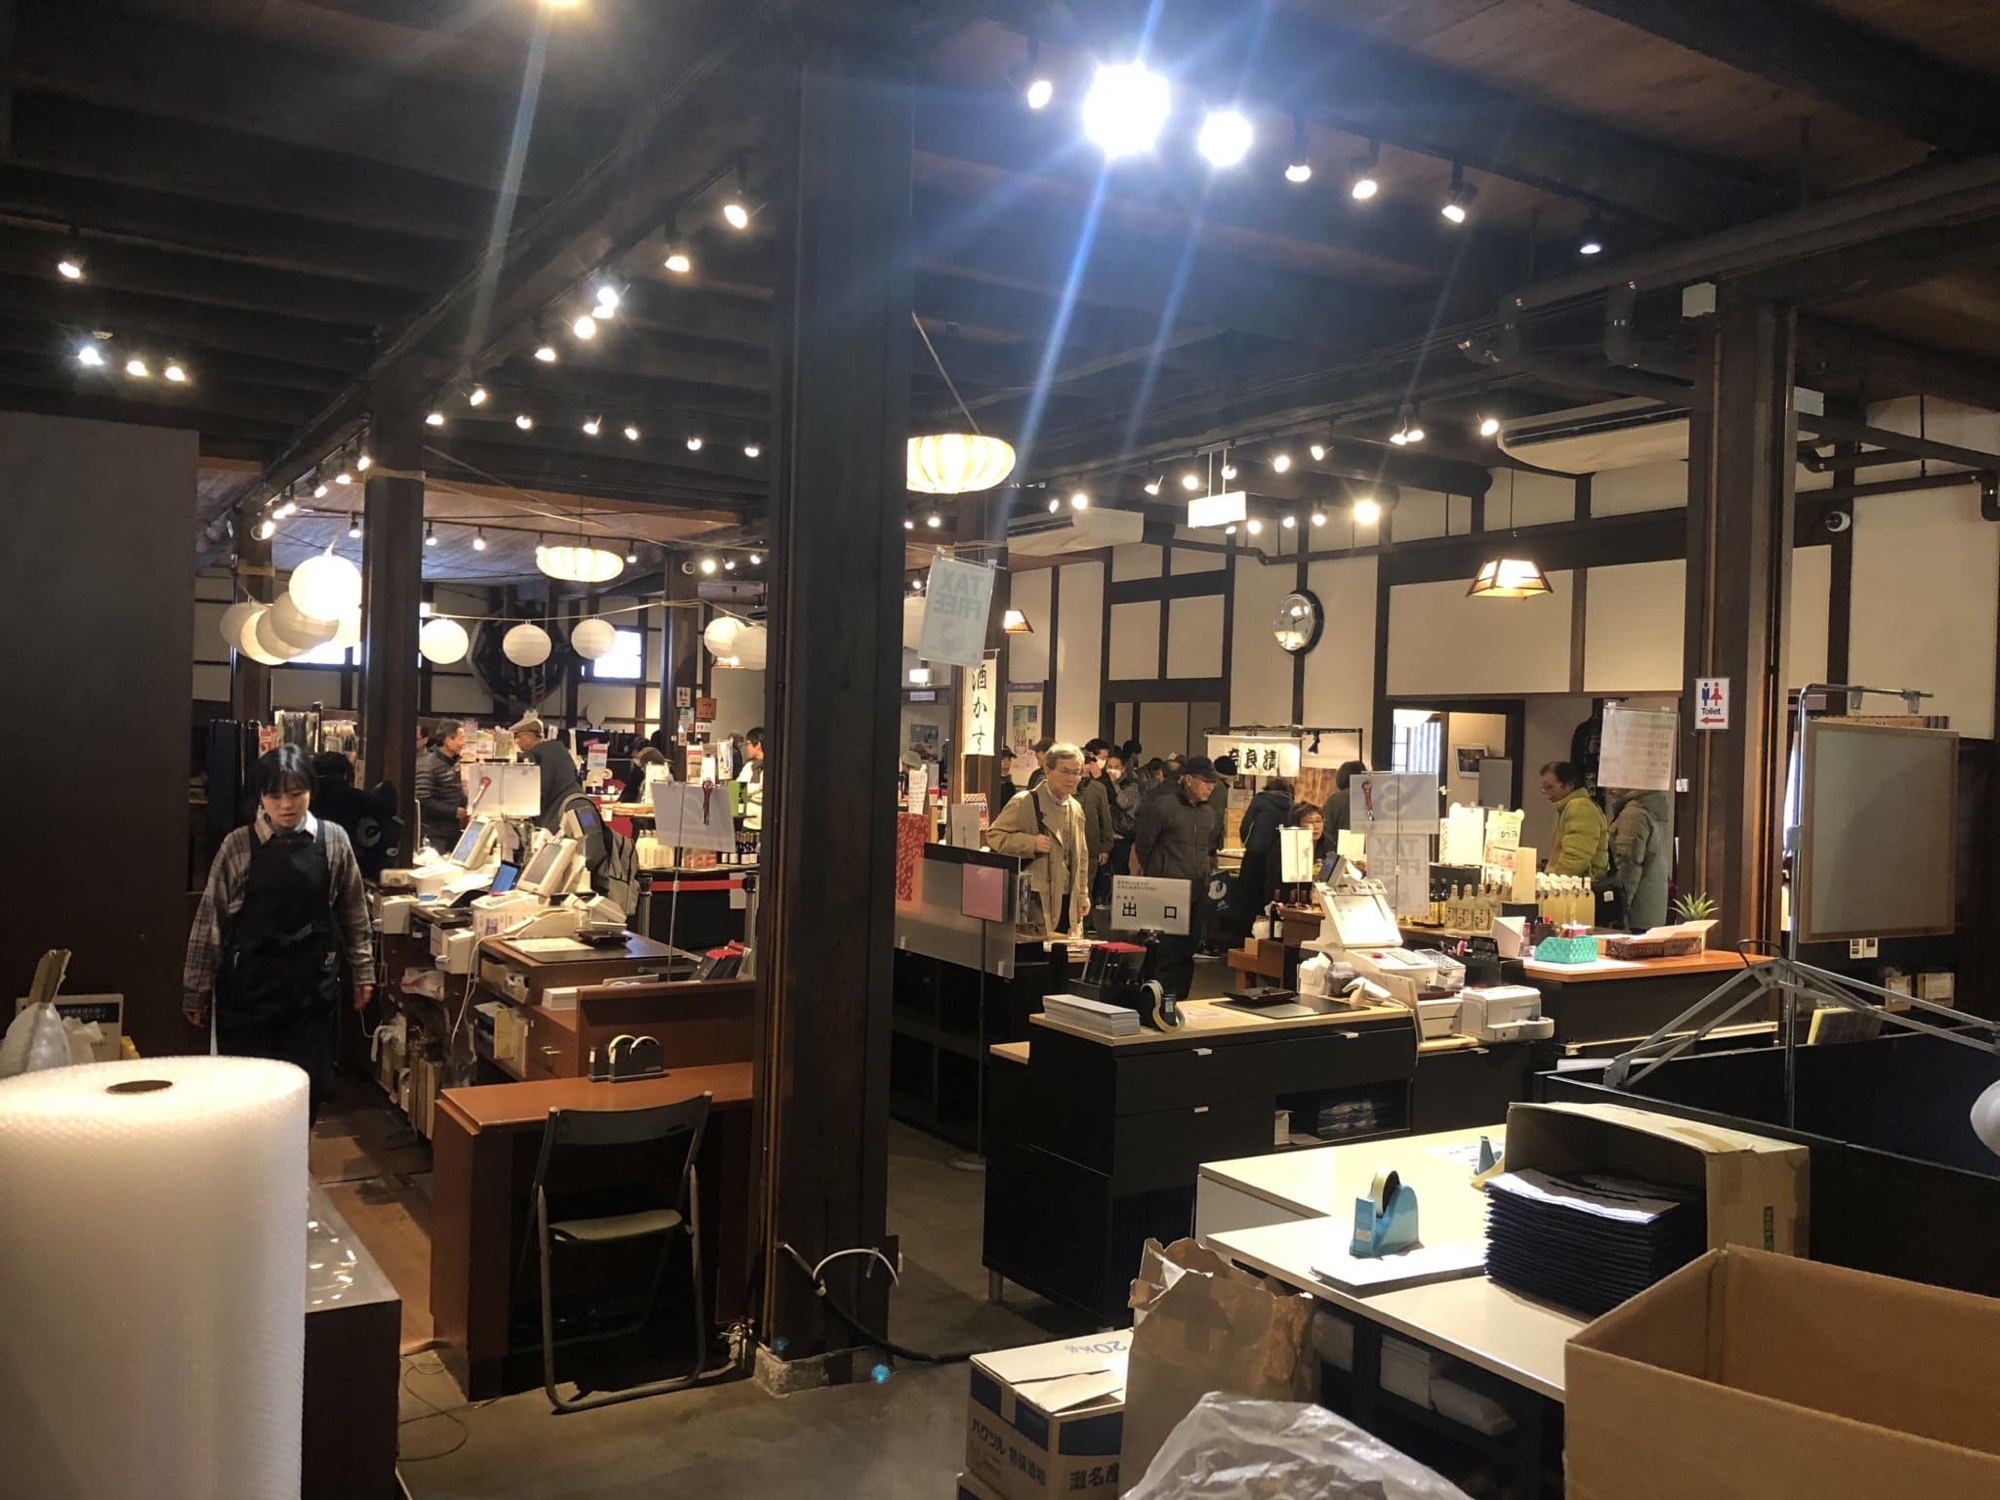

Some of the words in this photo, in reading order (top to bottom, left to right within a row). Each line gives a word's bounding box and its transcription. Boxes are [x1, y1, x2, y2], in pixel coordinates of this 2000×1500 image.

[971, 663, 988, 752] 酒かす
[1700, 707, 1721, 715] Toilet
[971, 1418, 1006, 1455] ハクツル
